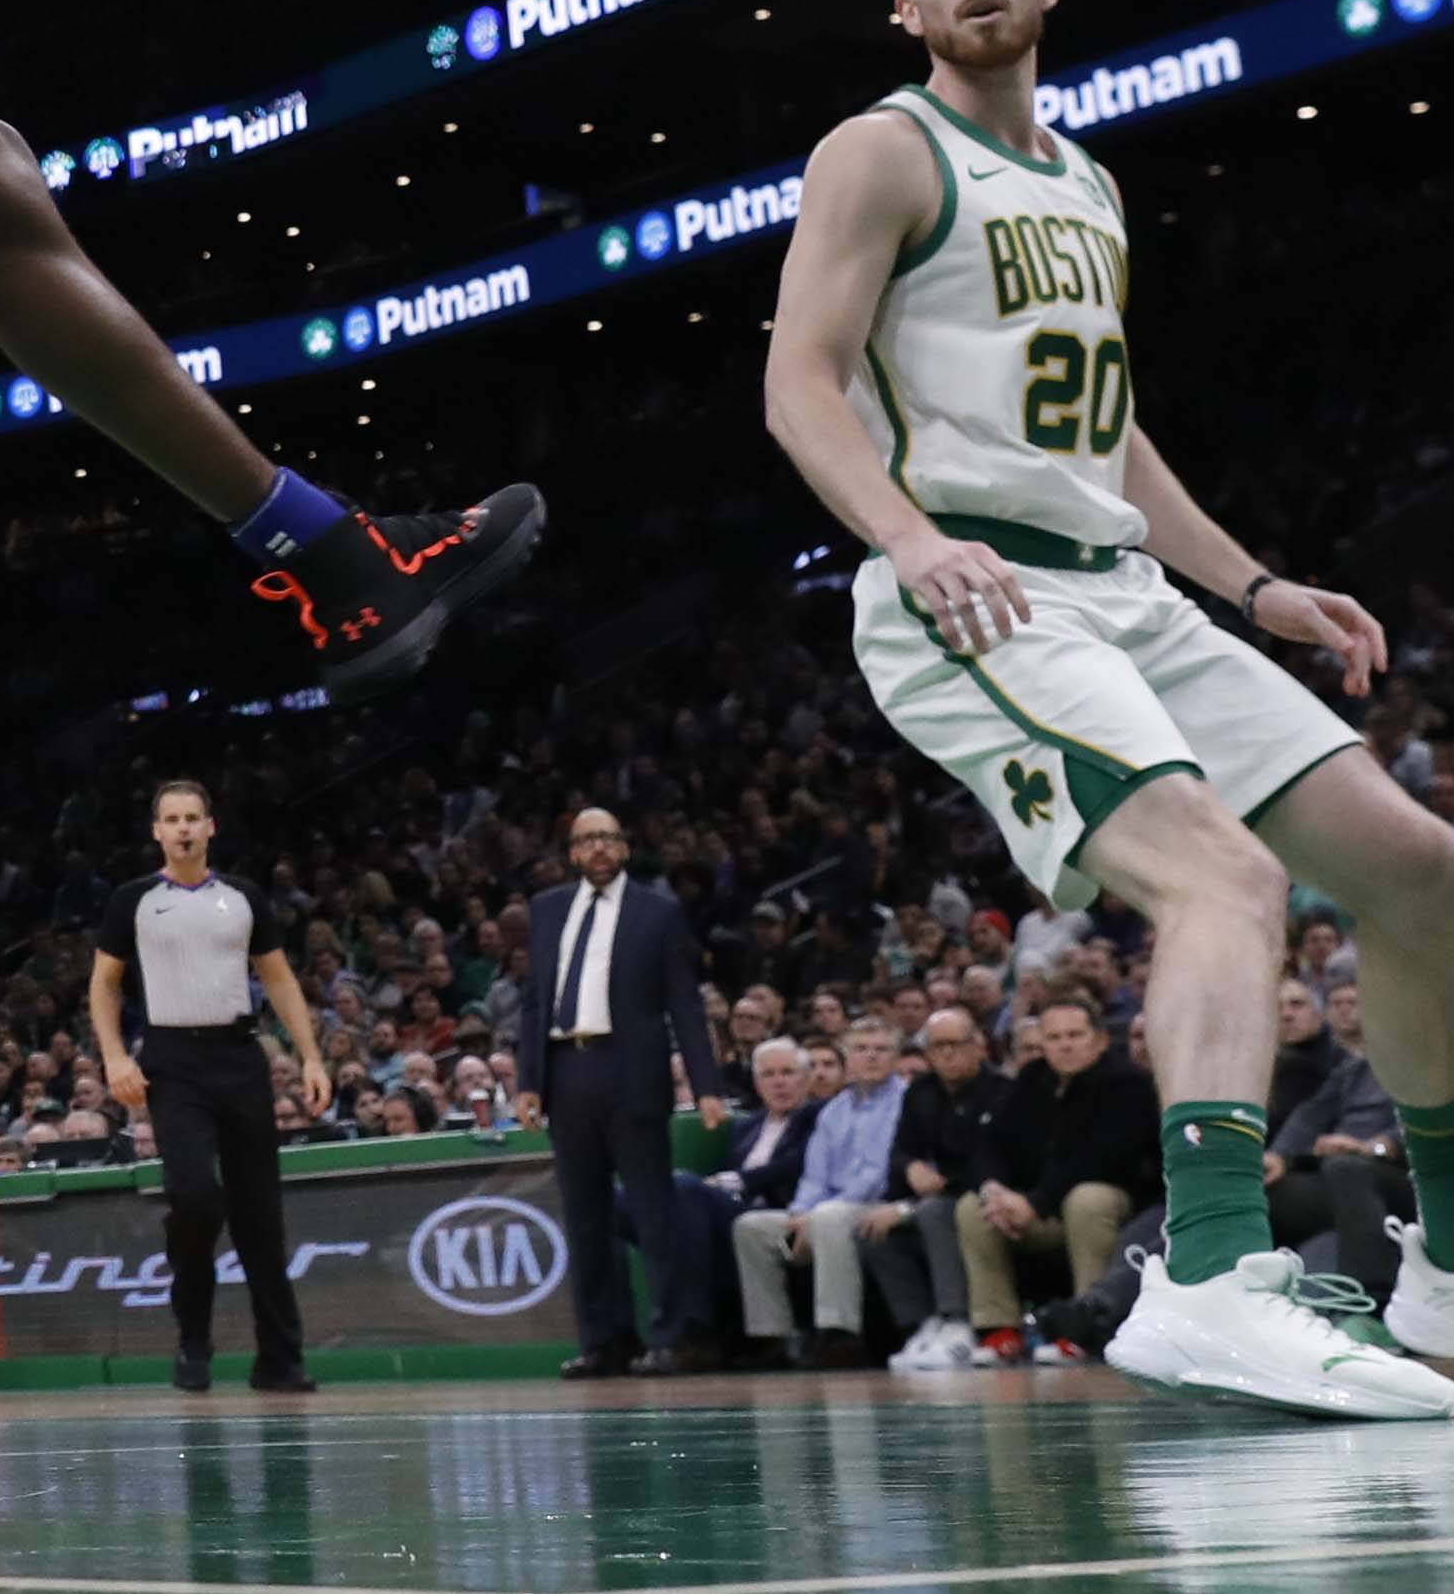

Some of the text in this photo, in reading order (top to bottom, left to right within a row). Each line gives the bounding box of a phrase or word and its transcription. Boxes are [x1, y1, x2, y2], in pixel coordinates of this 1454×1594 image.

[1033, 37, 1242, 130] Putnam
[675, 175, 804, 252] Putna
[376, 263, 530, 345] Putnam
[1022, 327, 1129, 458] 20
[434, 1226, 538, 1290] KIA
